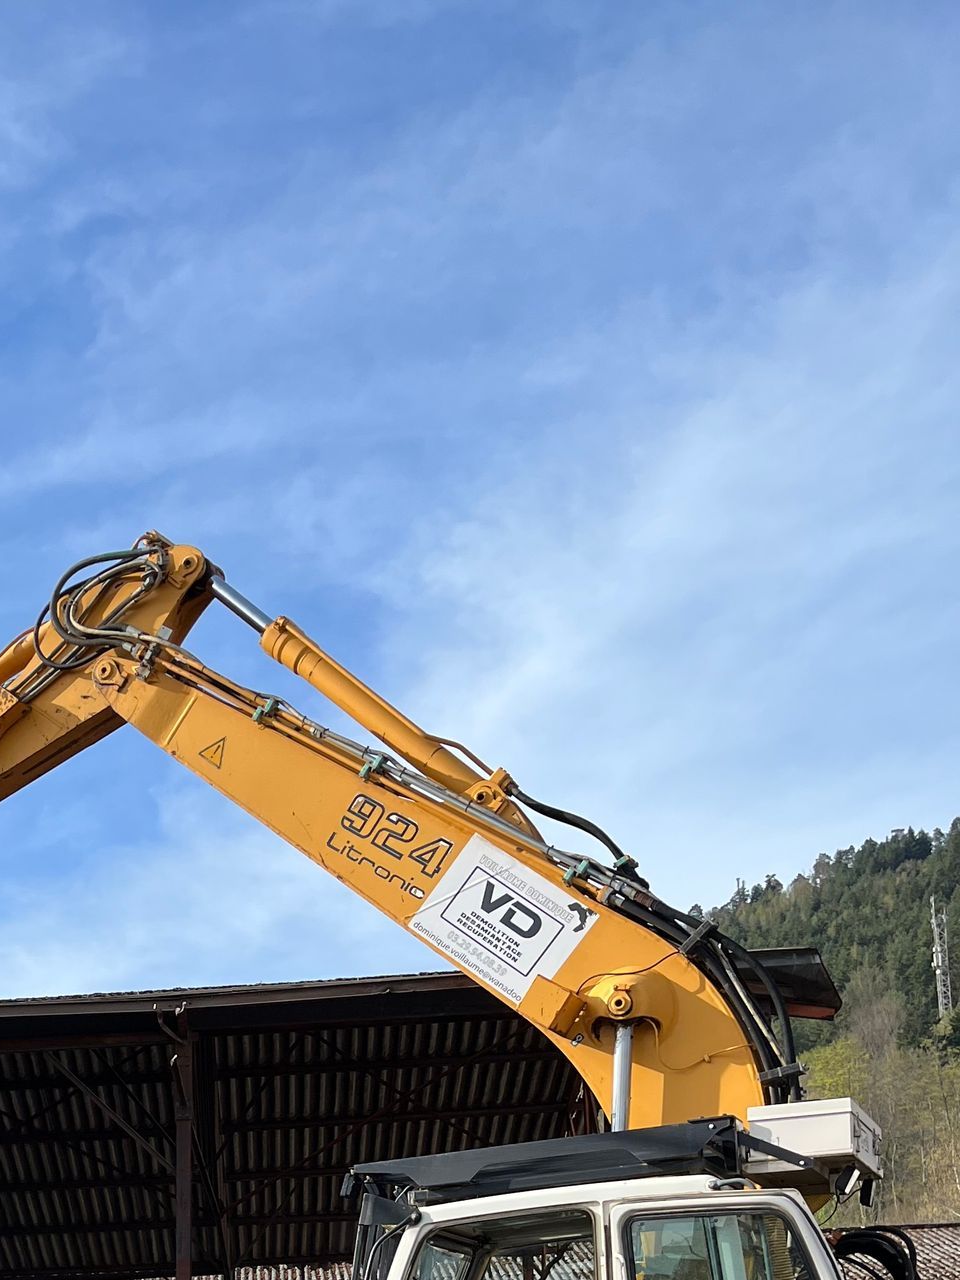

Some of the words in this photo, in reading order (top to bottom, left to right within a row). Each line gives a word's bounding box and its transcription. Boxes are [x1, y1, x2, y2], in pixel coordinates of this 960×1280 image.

[341, 793, 454, 879] 924
[326, 831, 426, 900] Litronic
[480, 880, 543, 939] VD
[525, 886, 575, 924] DOMINIQUE
[456, 917, 519, 963] RECUPERATION
[460, 912, 523, 958] DESAMIANTAGE
[470, 911, 521, 948] DEMOLITION
